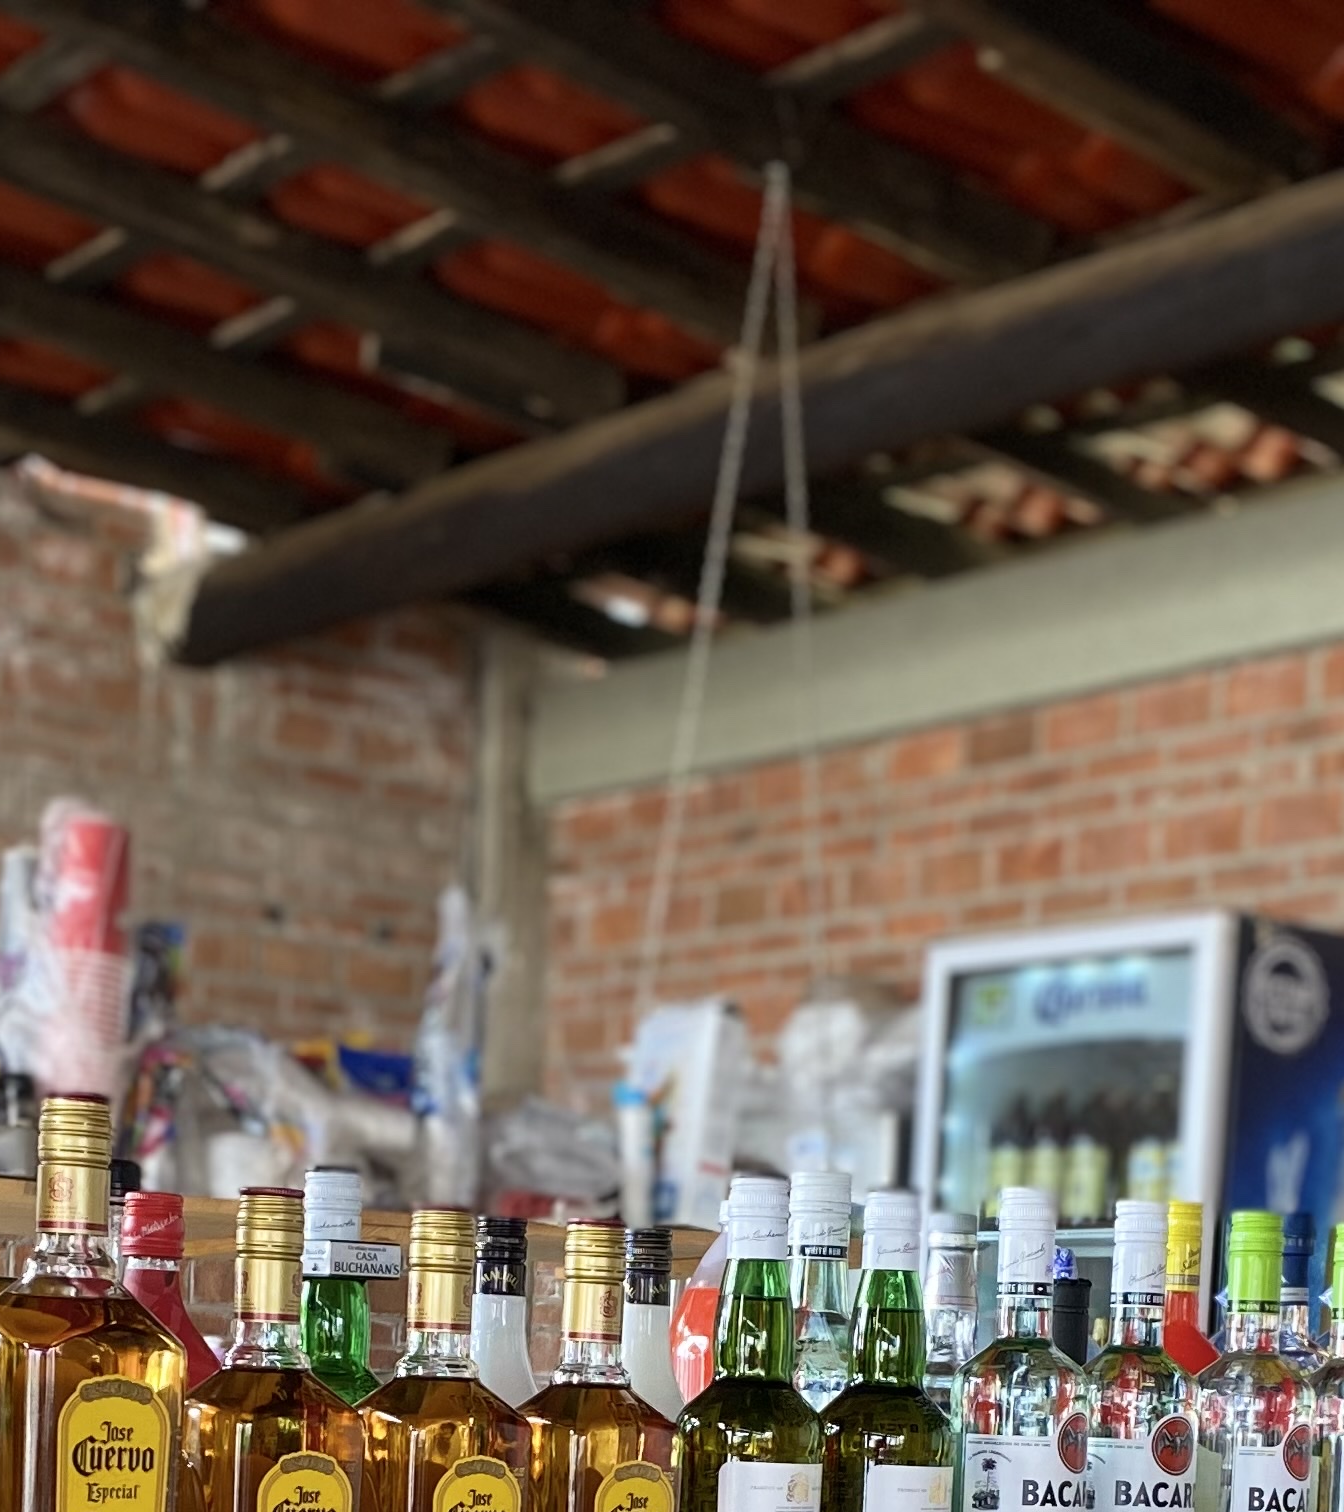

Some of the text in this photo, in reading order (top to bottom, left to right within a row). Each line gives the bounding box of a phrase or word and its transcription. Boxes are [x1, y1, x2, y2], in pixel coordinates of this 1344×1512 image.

[355, 1251, 379, 1261] CASA
[333, 1261, 400, 1276] BUCHANAN'S
[100, 1420, 135, 1445] Jose
[72, 1435, 155, 1478] Cuervo
[86, 1481, 141, 1503] Especial
[293, 1485, 320, 1506] Jose
[467, 1488, 493, 1508] Jose
[625, 1492, 649, 1512] Jose
[1114, 1479, 1196, 1508] BACAR
